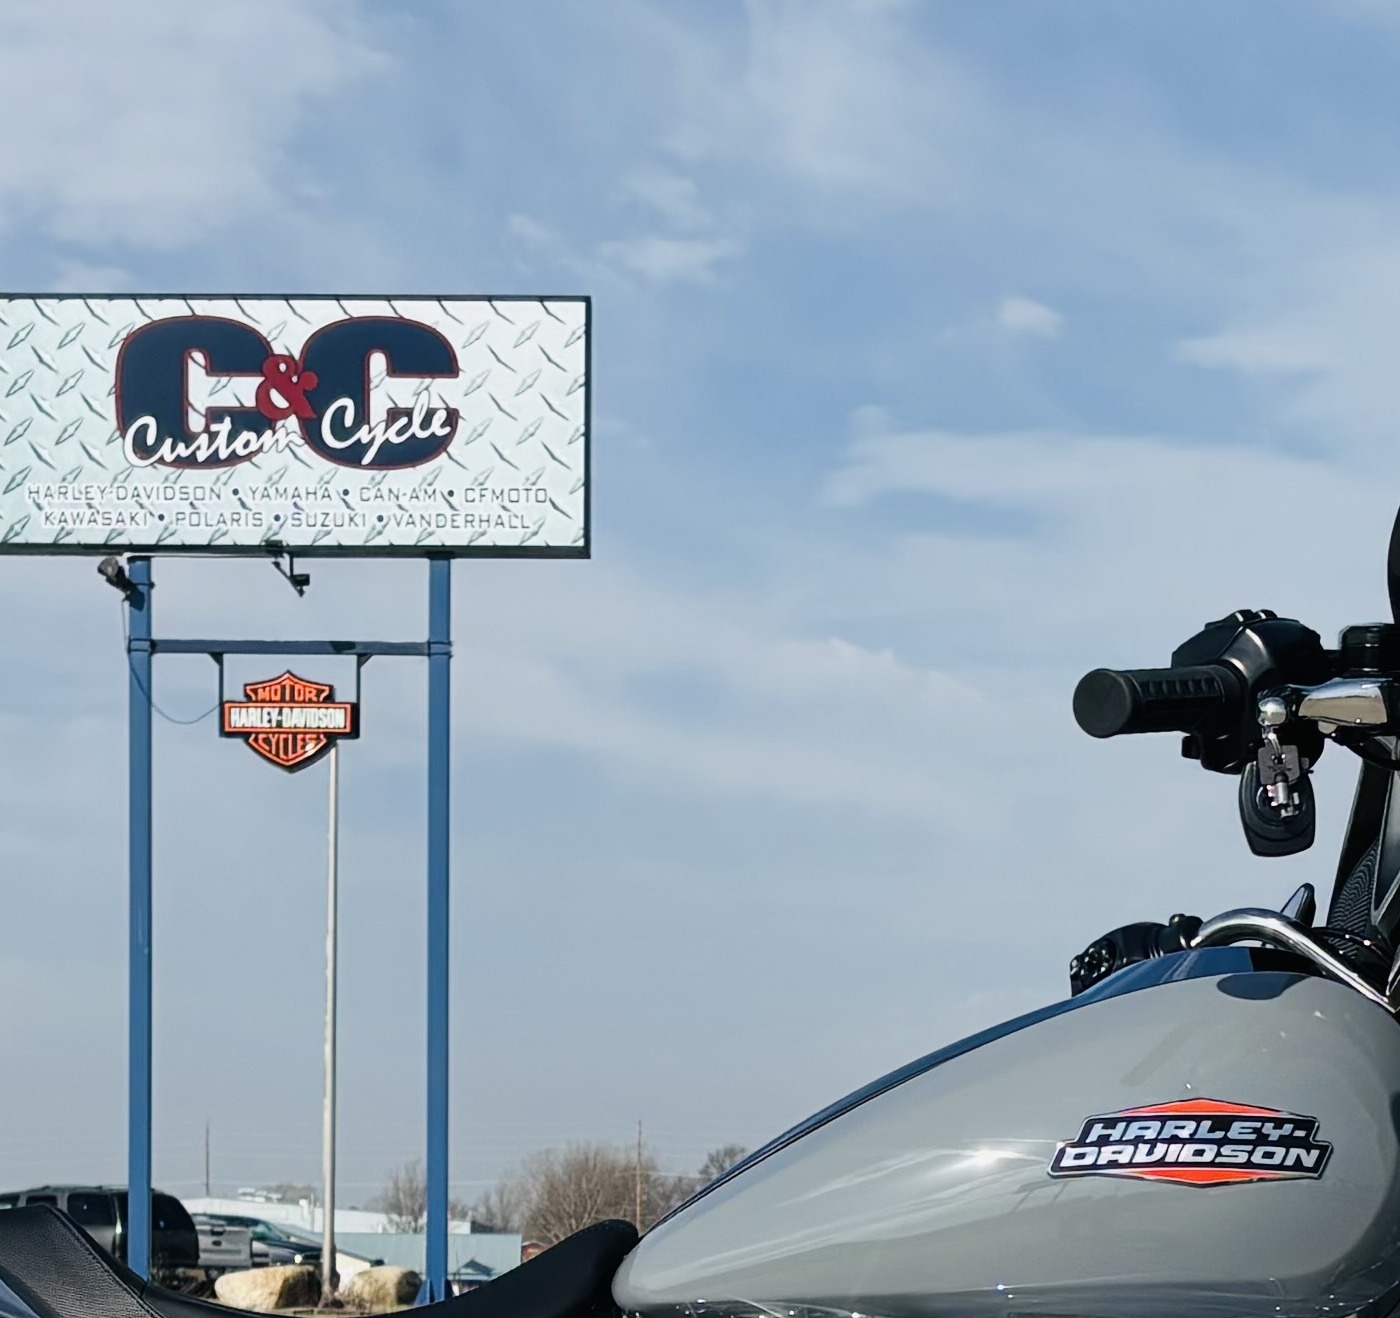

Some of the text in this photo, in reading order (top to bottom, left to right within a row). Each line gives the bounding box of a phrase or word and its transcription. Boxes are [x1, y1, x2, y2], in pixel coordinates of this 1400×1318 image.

[123, 389, 452, 468] Custom Cycle
[249, 485, 333, 501] YAMAHA
[358, 486, 438, 503] CAN-AM
[463, 487, 548, 503] CFMOTO
[43, 510, 531, 529] KAWASAKI POLARIS SUZUKI VANDERHALL
[256, 680, 318, 702] MOTOR
[230, 707, 345, 728] HARLEY-DAVIDSON
[257, 733, 318, 760] CYCLES
[1085, 1120, 1307, 1143] HARLEY-
[1059, 1143, 1320, 1167] DAVIDSON
